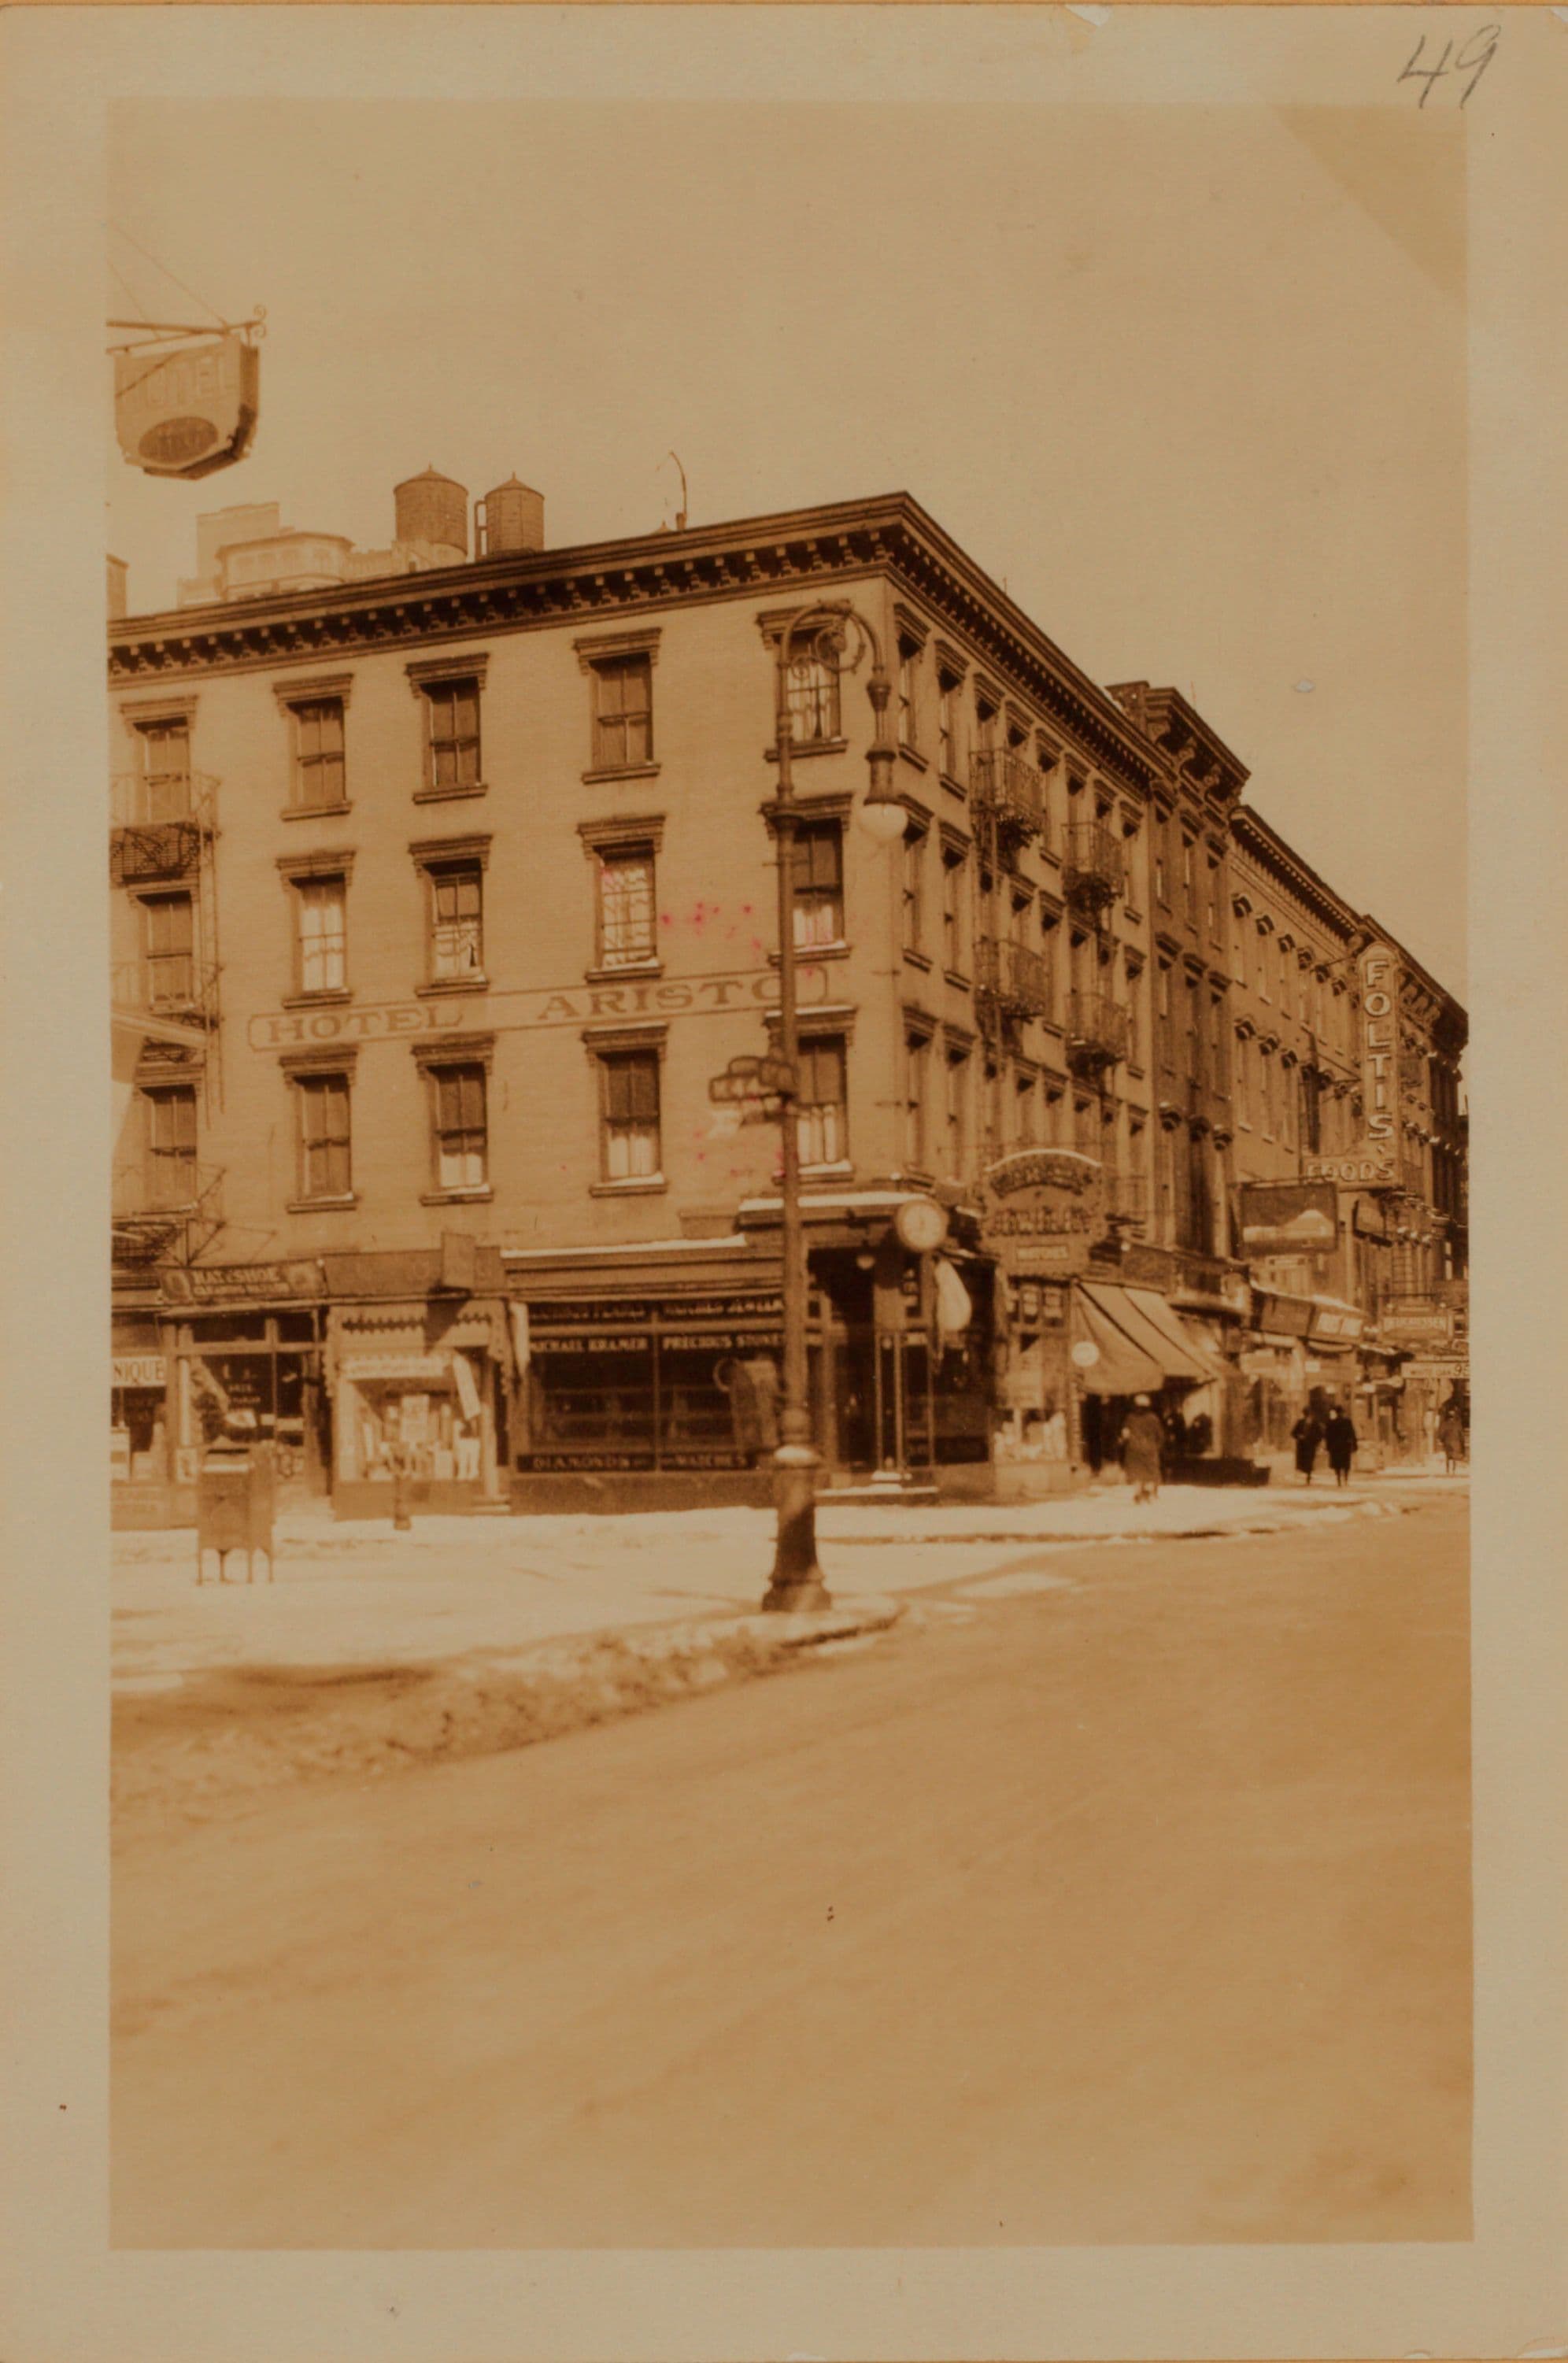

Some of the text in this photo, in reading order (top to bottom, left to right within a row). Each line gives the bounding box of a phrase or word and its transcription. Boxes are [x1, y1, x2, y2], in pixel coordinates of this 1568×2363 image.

[1396, 24, 1502, 110] 49
[266, 1003, 464, 1045] HOTEL
[1363, 959, 1394, 1141] FOLTIS
[1307, 1158, 1396, 1183] FOODS
